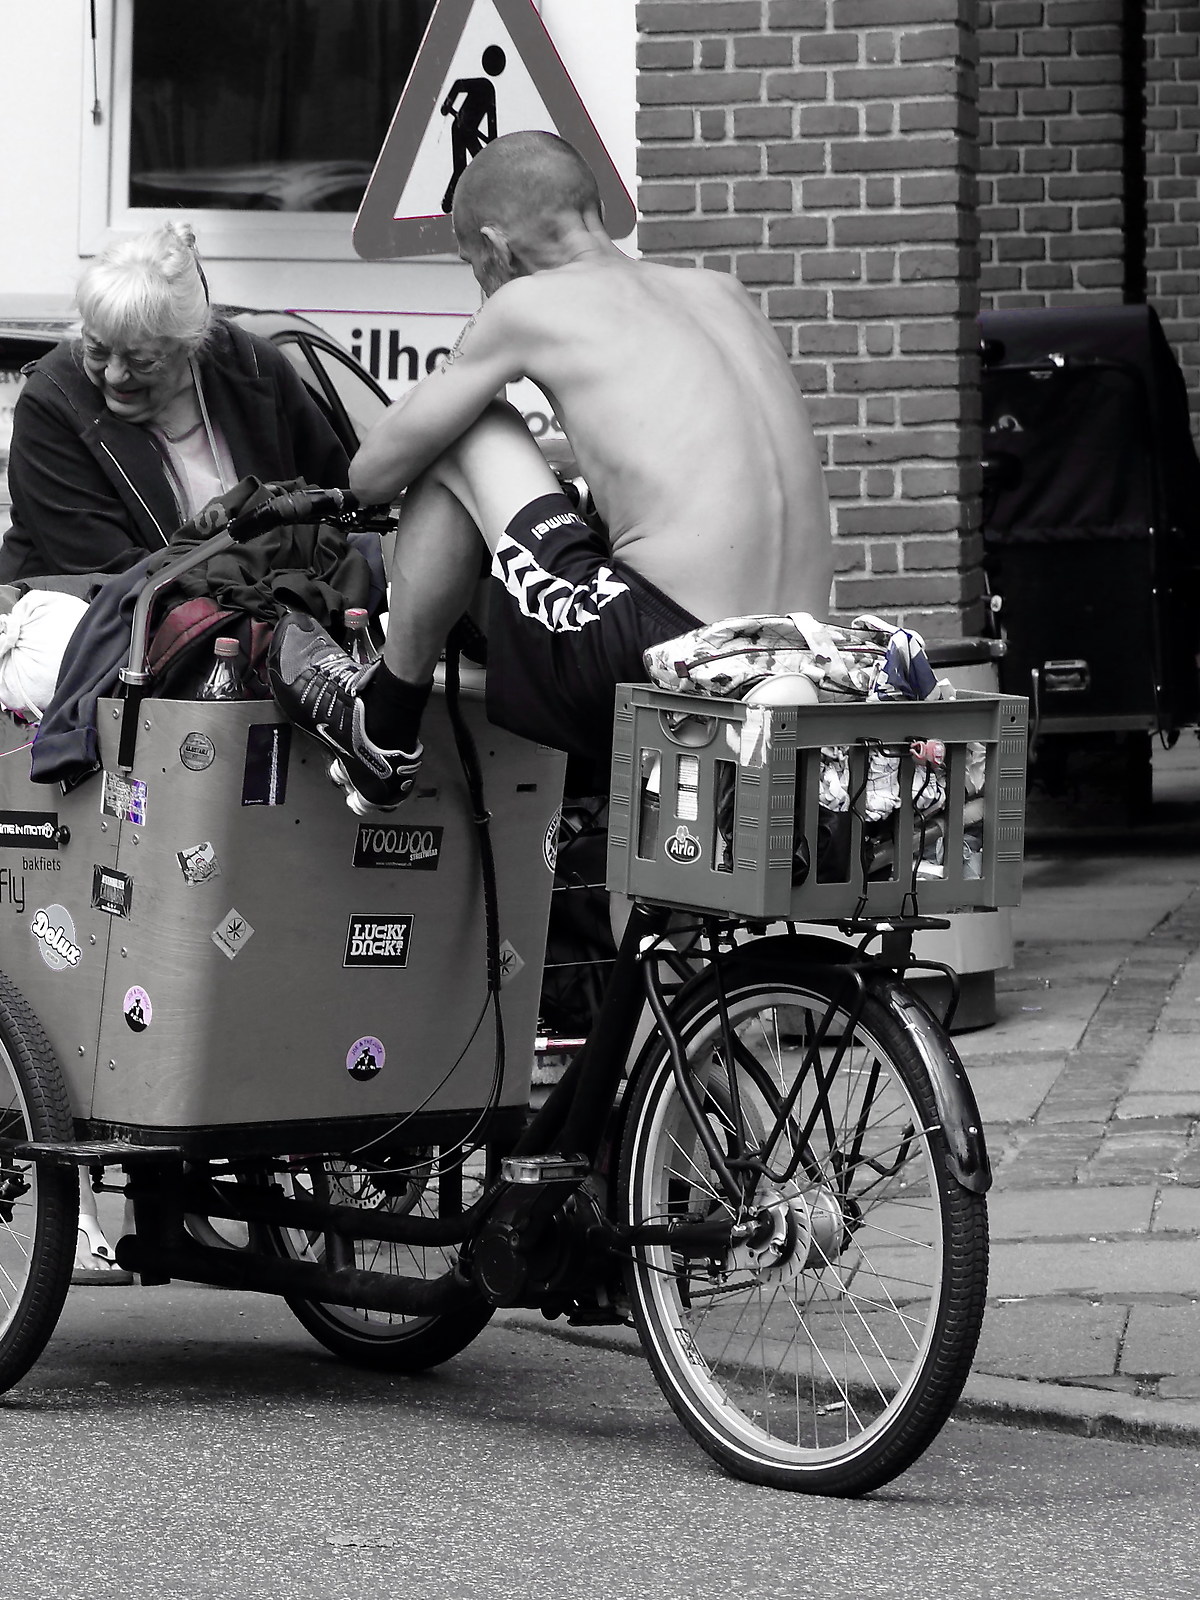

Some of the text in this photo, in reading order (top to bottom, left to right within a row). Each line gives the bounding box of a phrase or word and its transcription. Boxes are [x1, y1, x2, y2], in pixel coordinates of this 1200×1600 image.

[360, 828, 434, 854] VOODOO
[670, 839, 695, 857] Arla
[22, 856, 62, 872] bakfiets
[352, 923, 407, 940] LUCKY
